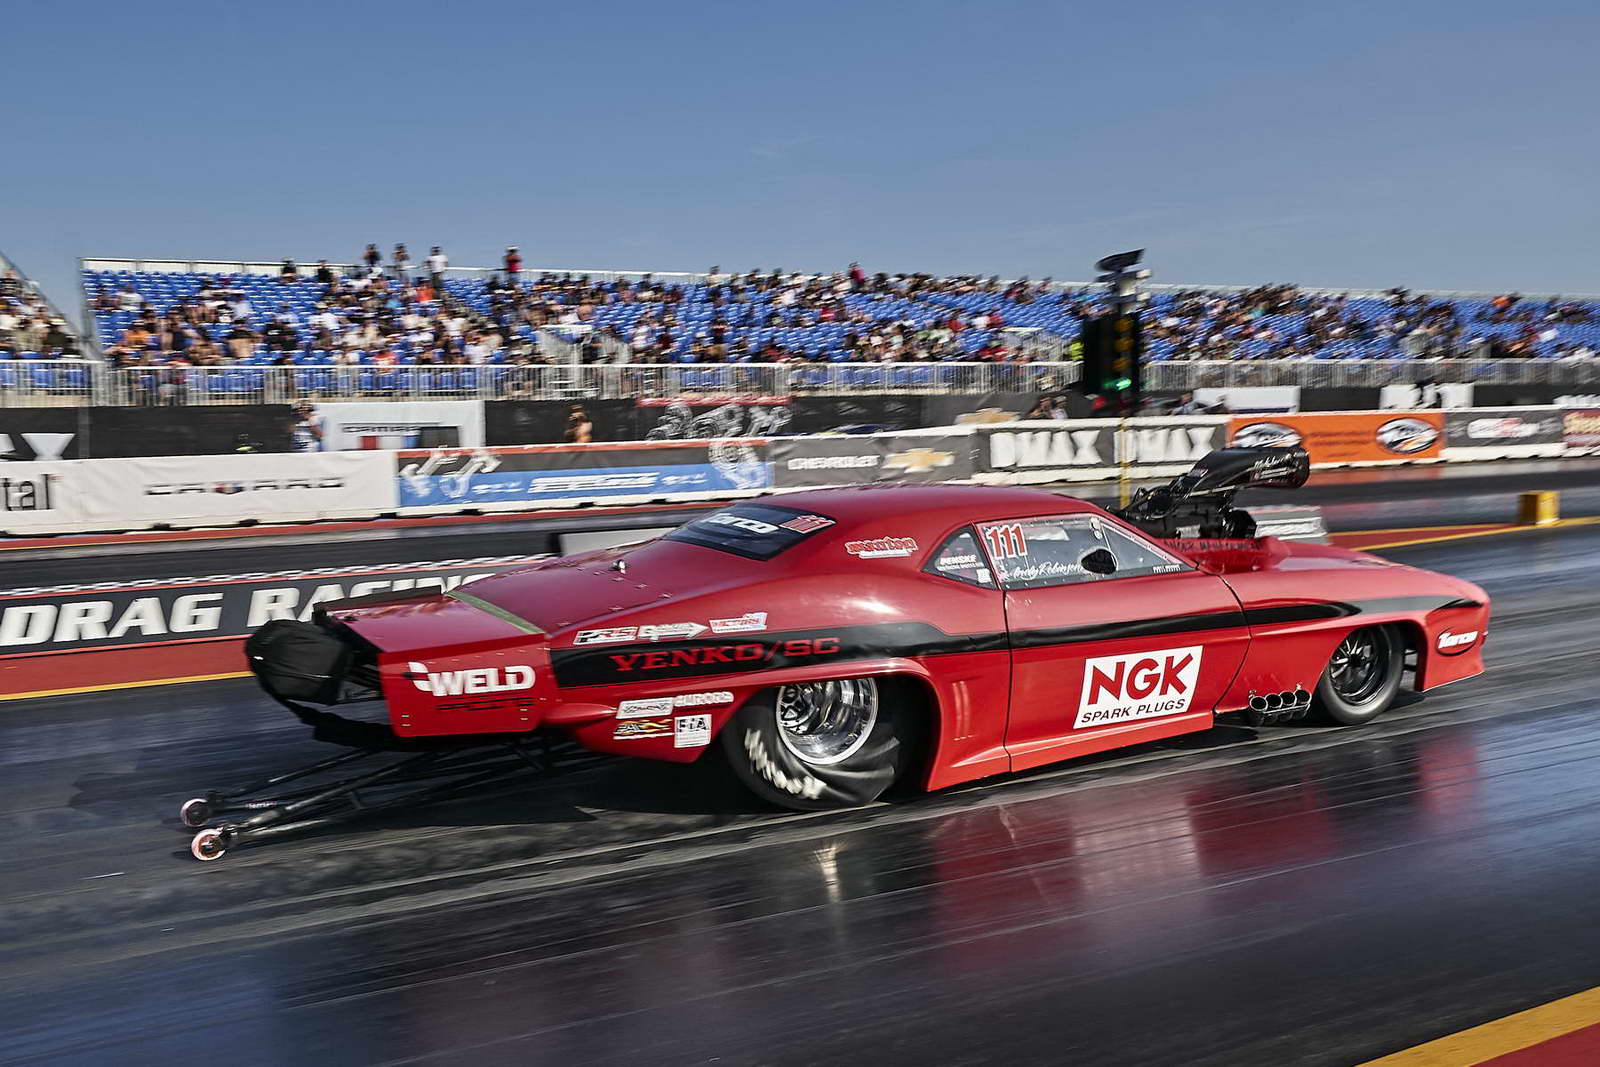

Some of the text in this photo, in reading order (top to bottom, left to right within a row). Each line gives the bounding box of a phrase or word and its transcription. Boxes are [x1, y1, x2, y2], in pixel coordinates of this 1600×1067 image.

[988, 428, 1101, 468] DMAX
[986, 523, 1028, 559] 111
[0, 592, 224, 647] DRAG
[609, 637, 841, 672] YENKO/SC
[427, 665, 536, 697] WELD
[1088, 653, 1193, 705] NGK
[1081, 698, 1185, 723] SPARK PLUGS
